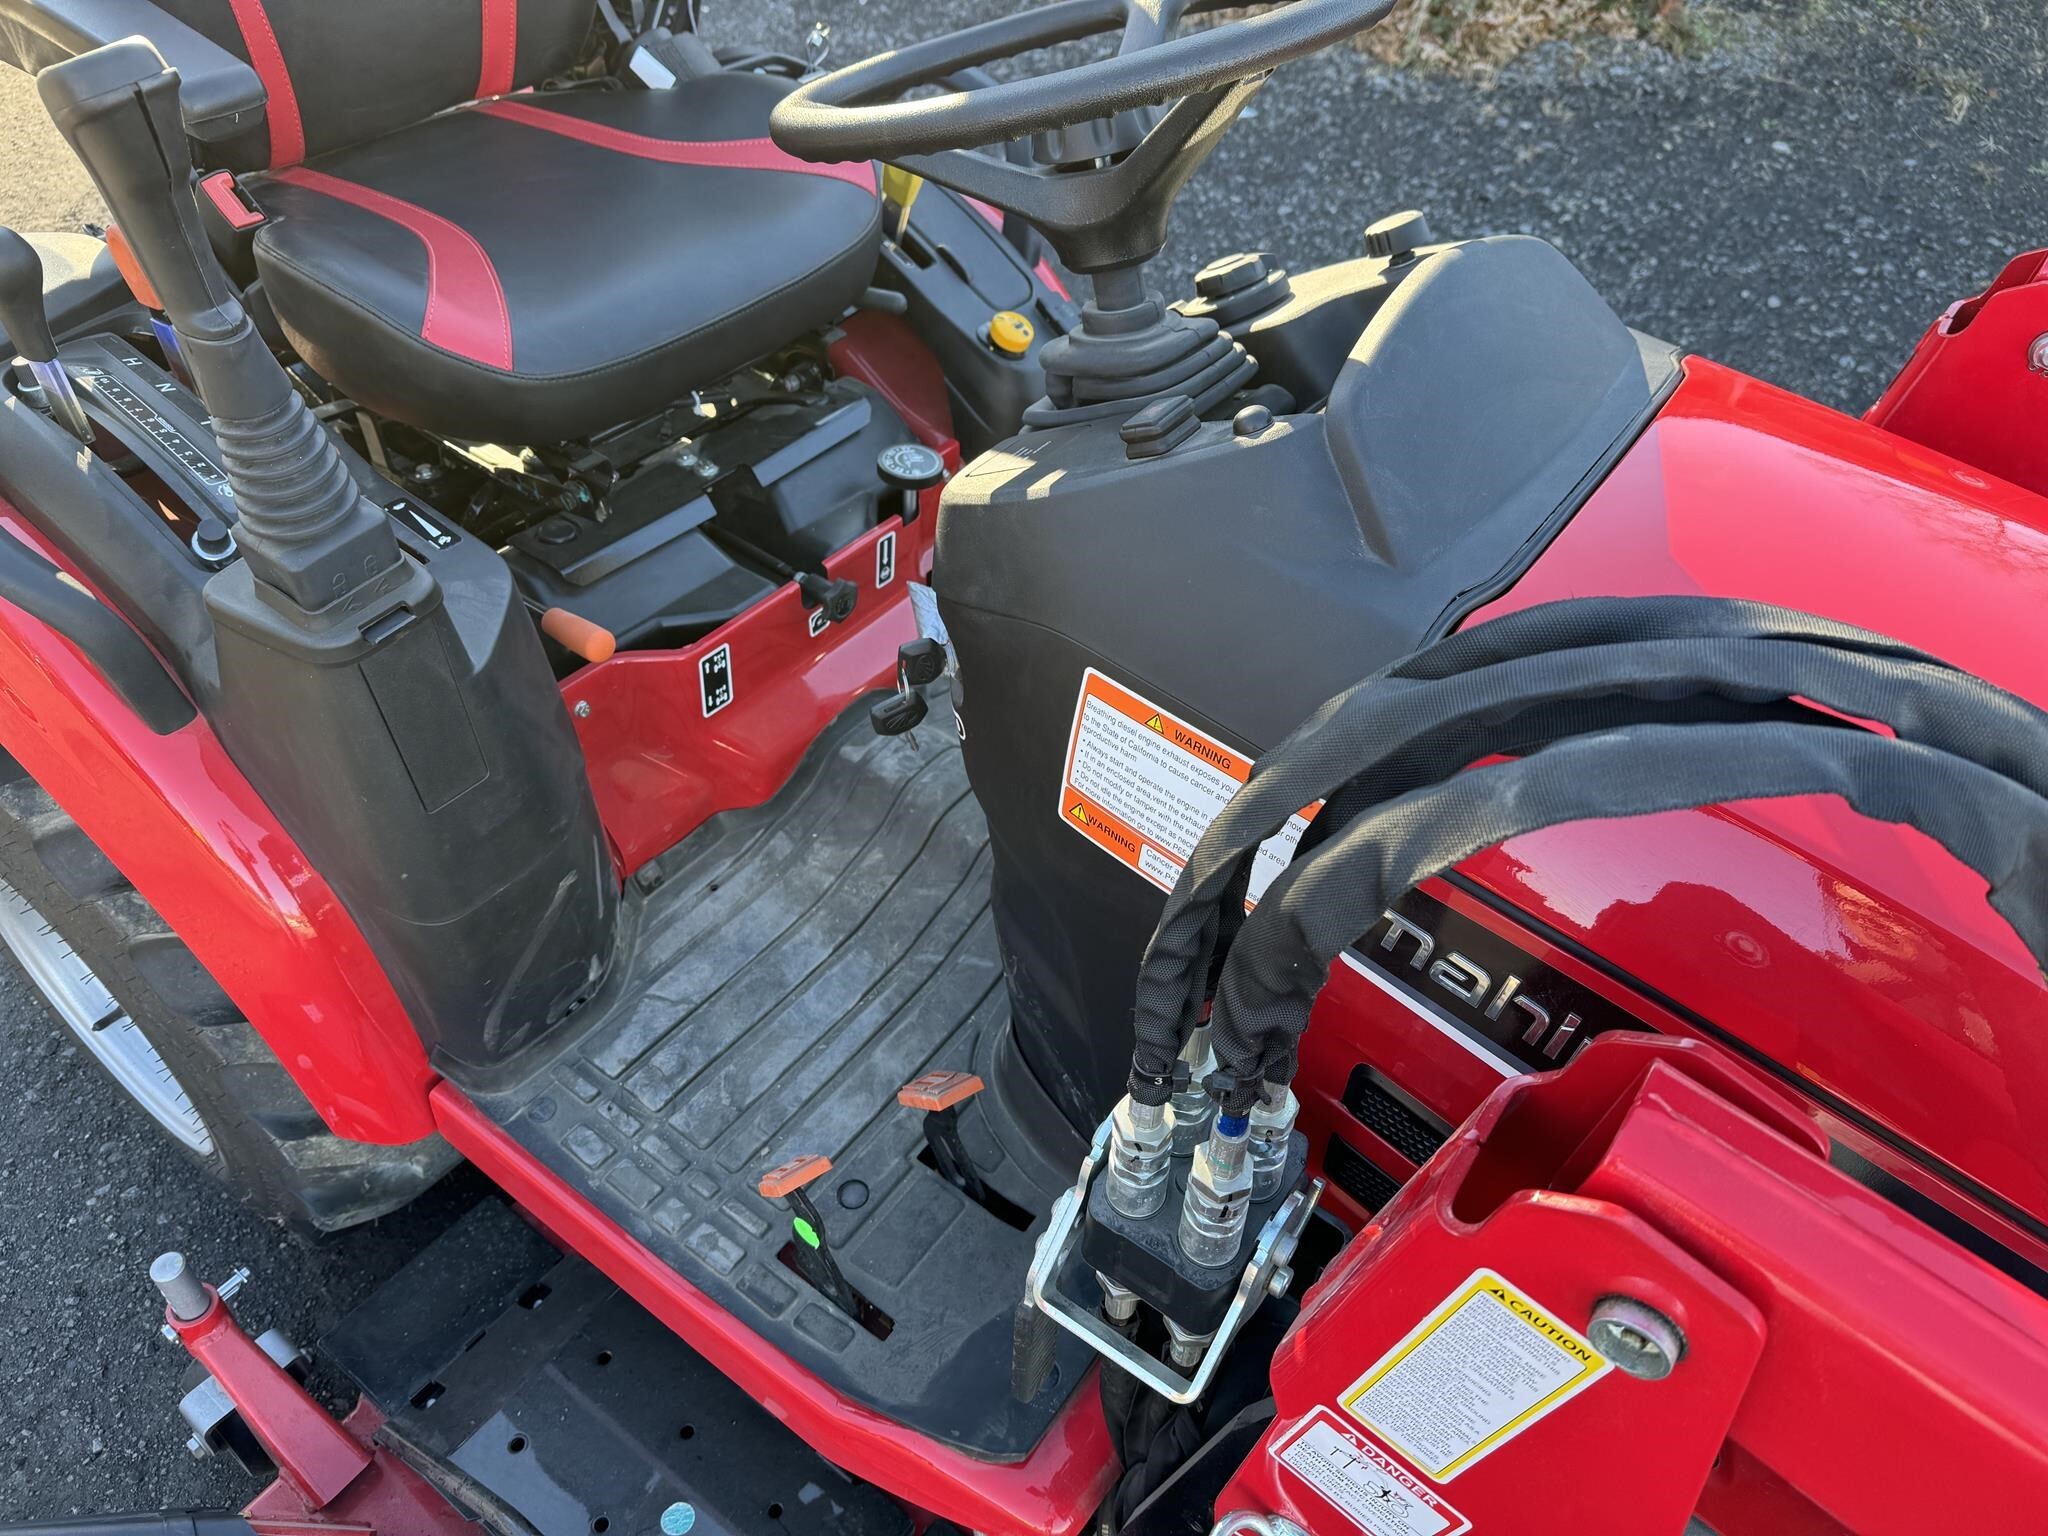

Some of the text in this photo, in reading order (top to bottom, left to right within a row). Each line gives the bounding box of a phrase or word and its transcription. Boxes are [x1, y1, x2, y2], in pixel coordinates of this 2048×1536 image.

[122, 357, 143, 366] H
[155, 382, 177, 392] N
[1080, 722, 1137, 762] reproductive harm
[1083, 712, 1089, 721] to
[1090, 716, 1101, 728] the
[1101, 722, 1119, 740] State
[1119, 734, 1127, 744] of
[1127, 738, 1159, 764] California
[1160, 759, 1167, 769] to
[1167, 765, 1189, 782] cause
[1190, 777, 1213, 797] cancer
[1085, 699, 1117, 726] Breathing
[1117, 719, 1137, 737] diesel
[1137, 732, 1160, 752] engine
[1162, 745, 1189, 767] exhaust
[1189, 763, 1220, 787] exposes
[1220, 781, 1234, 796] you
[1173, 729, 1231, 770] WARNING
[1074, 777, 1084, 788] For
[1085, 786, 1100, 800] more
[1101, 796, 1136, 824] information
[1136, 821, 1145, 832] go
[1146, 827, 1153, 836] to
[1080, 770, 1089, 782] Do
[1089, 777, 1099, 789] not
[1100, 784, 1111, 797] idle
[1112, 792, 1122, 805] the
[1123, 800, 1144, 821] engine
[1145, 814, 1167, 834] except
[1168, 829, 1177, 839] as
[1082, 760, 1091, 772] Do
[1092, 768, 1102, 779] not
[1102, 774, 1124, 796] modify
[1125, 790, 1132, 799] or
[1133, 795, 1156, 815] tamper
[1157, 809, 1171, 823] with
[1172, 819, 1184, 831] the
[1086, 740, 1108, 761] Always
[1109, 755, 1123, 769] start
[1124, 764, 1137, 778] and
[1137, 772, 1163, 796] operate
[1164, 789, 1175, 801] the
[1176, 797, 1199, 817] engine
[1200, 811, 1207, 820] in
[1089, 753, 1096, 763] in
[1096, 759, 1105, 769] an
[1106, 764, 1135, 789] enclosed
[1168, 803, 1179, 816] the
[1180, 811, 1206, 833] exhaus
[1088, 813, 1135, 854] WARNING
[1146, 847, 1172, 871] Cancer
[1154, 1077, 1163, 1085] 3
[1508, 1298, 1592, 1361] CAUTION
[1360, 1445, 1439, 1507] DANGER
